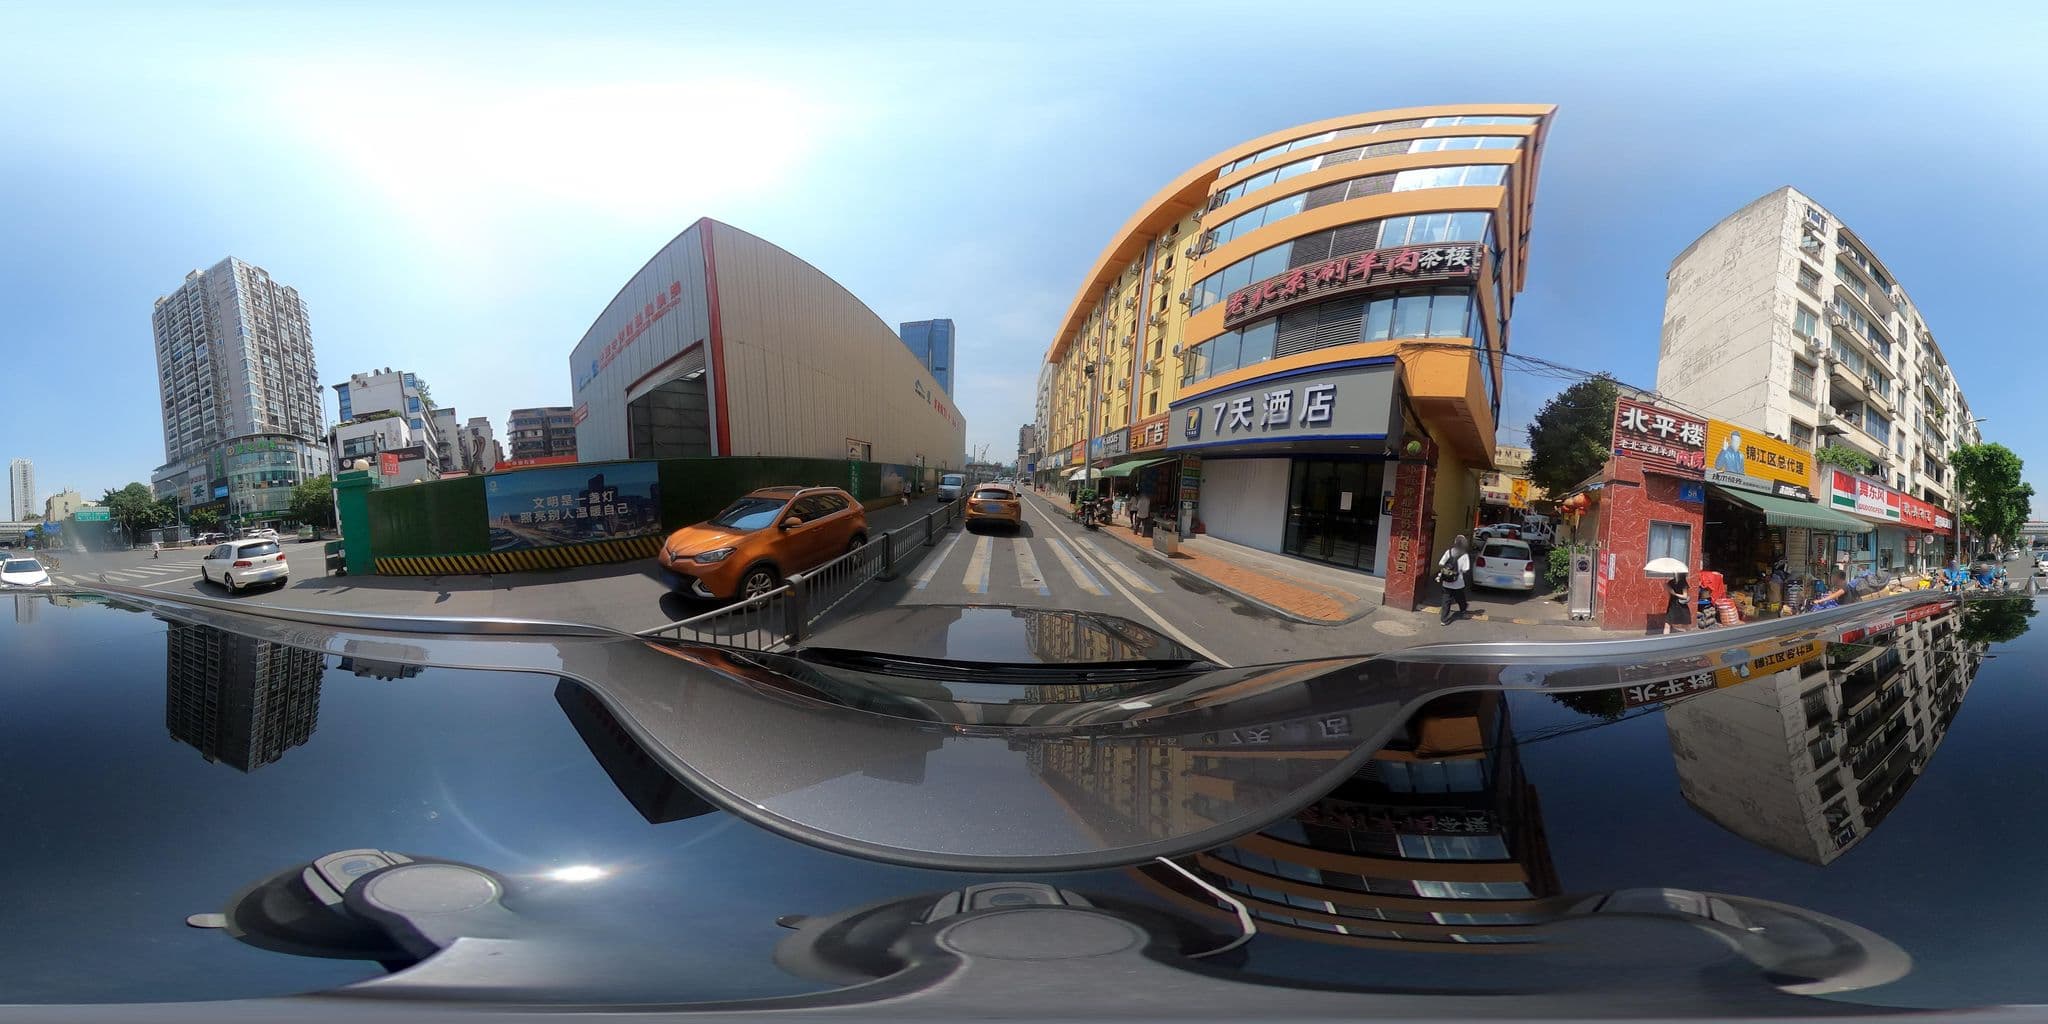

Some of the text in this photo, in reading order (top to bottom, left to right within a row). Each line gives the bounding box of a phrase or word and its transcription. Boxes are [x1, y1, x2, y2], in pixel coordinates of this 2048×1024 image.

[1226, 248, 1420, 316] 老北京涮羊肉
[1419, 247, 1472, 269] 茶楼
[1213, 384, 1336, 431] 7天酒店
[1621, 408, 1704, 447] 北平楼
[1746, 445, 1804, 475] 锦江区总代理
[520, 502, 629, 524] 照亮别人温暖自己
[533, 490, 615, 510] 文明是一盏灯
